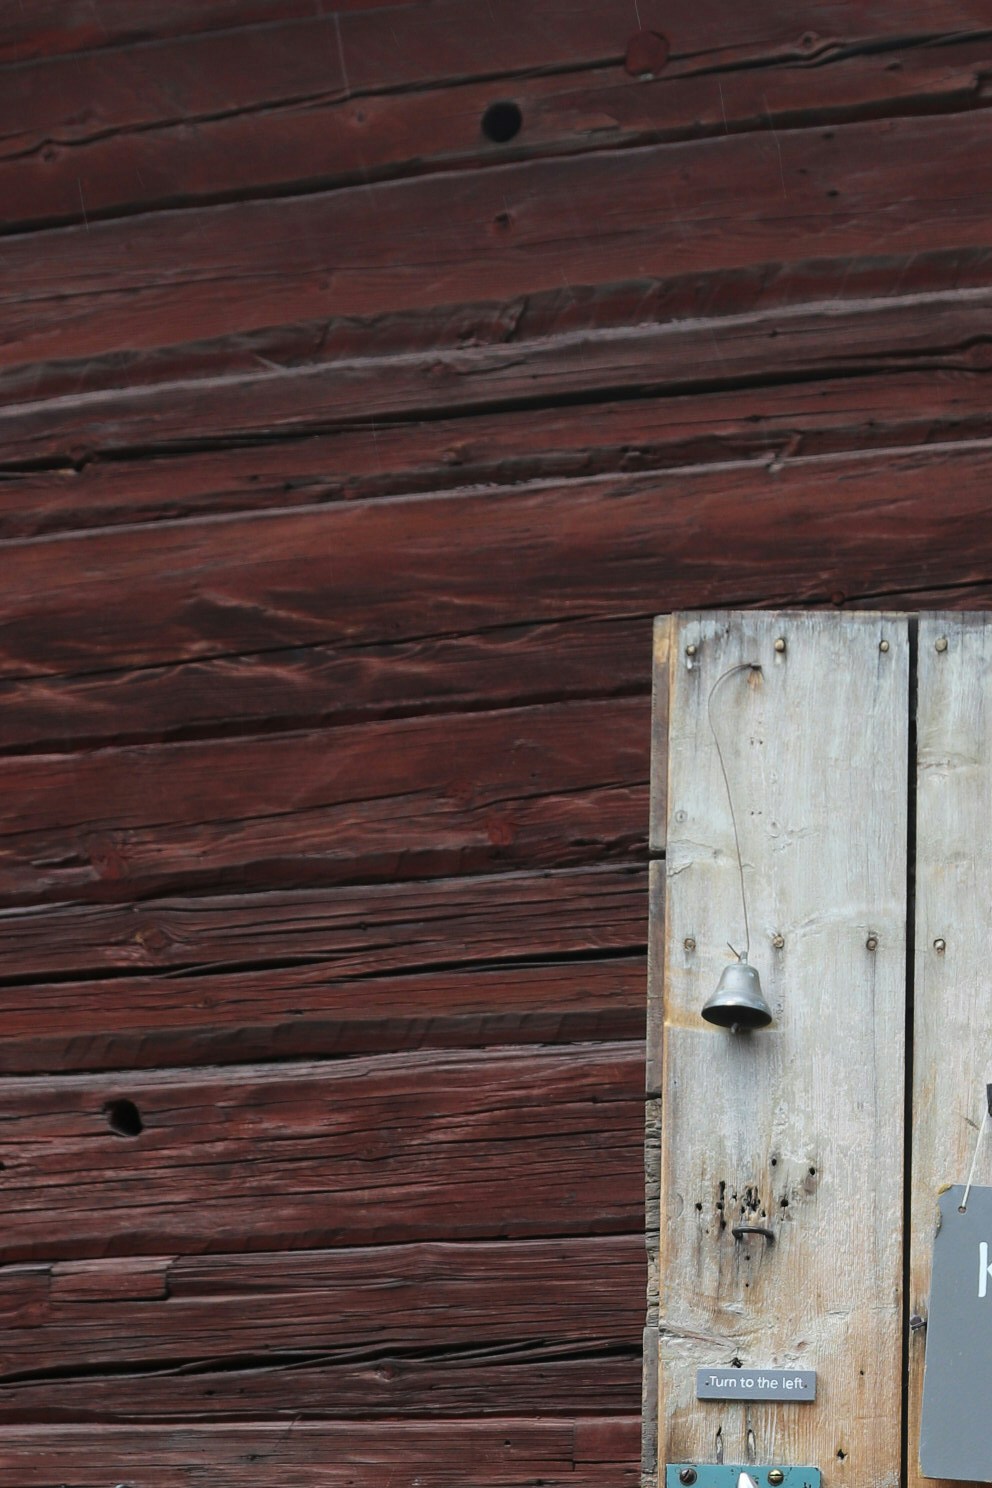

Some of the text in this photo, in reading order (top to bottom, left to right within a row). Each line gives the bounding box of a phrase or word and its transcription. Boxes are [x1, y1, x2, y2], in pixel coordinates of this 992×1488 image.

[709, 1376, 803, 1389] Turn to the left
